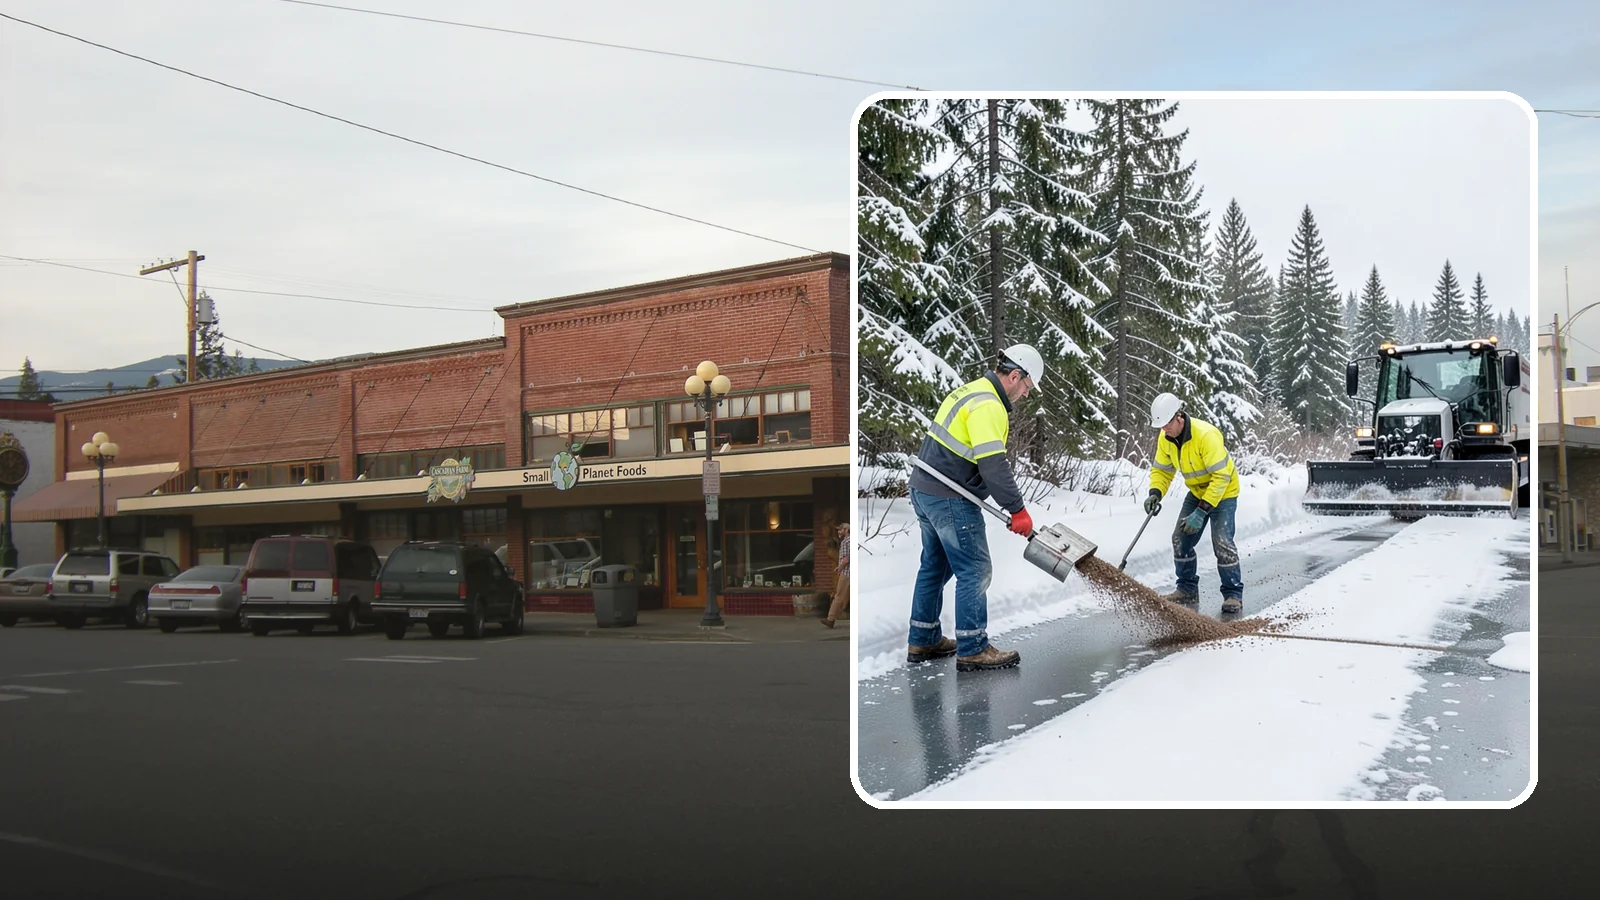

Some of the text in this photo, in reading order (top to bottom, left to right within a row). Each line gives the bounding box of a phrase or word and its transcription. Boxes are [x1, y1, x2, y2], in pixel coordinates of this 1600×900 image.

[523, 464, 647, 483] Small Planet Foods
